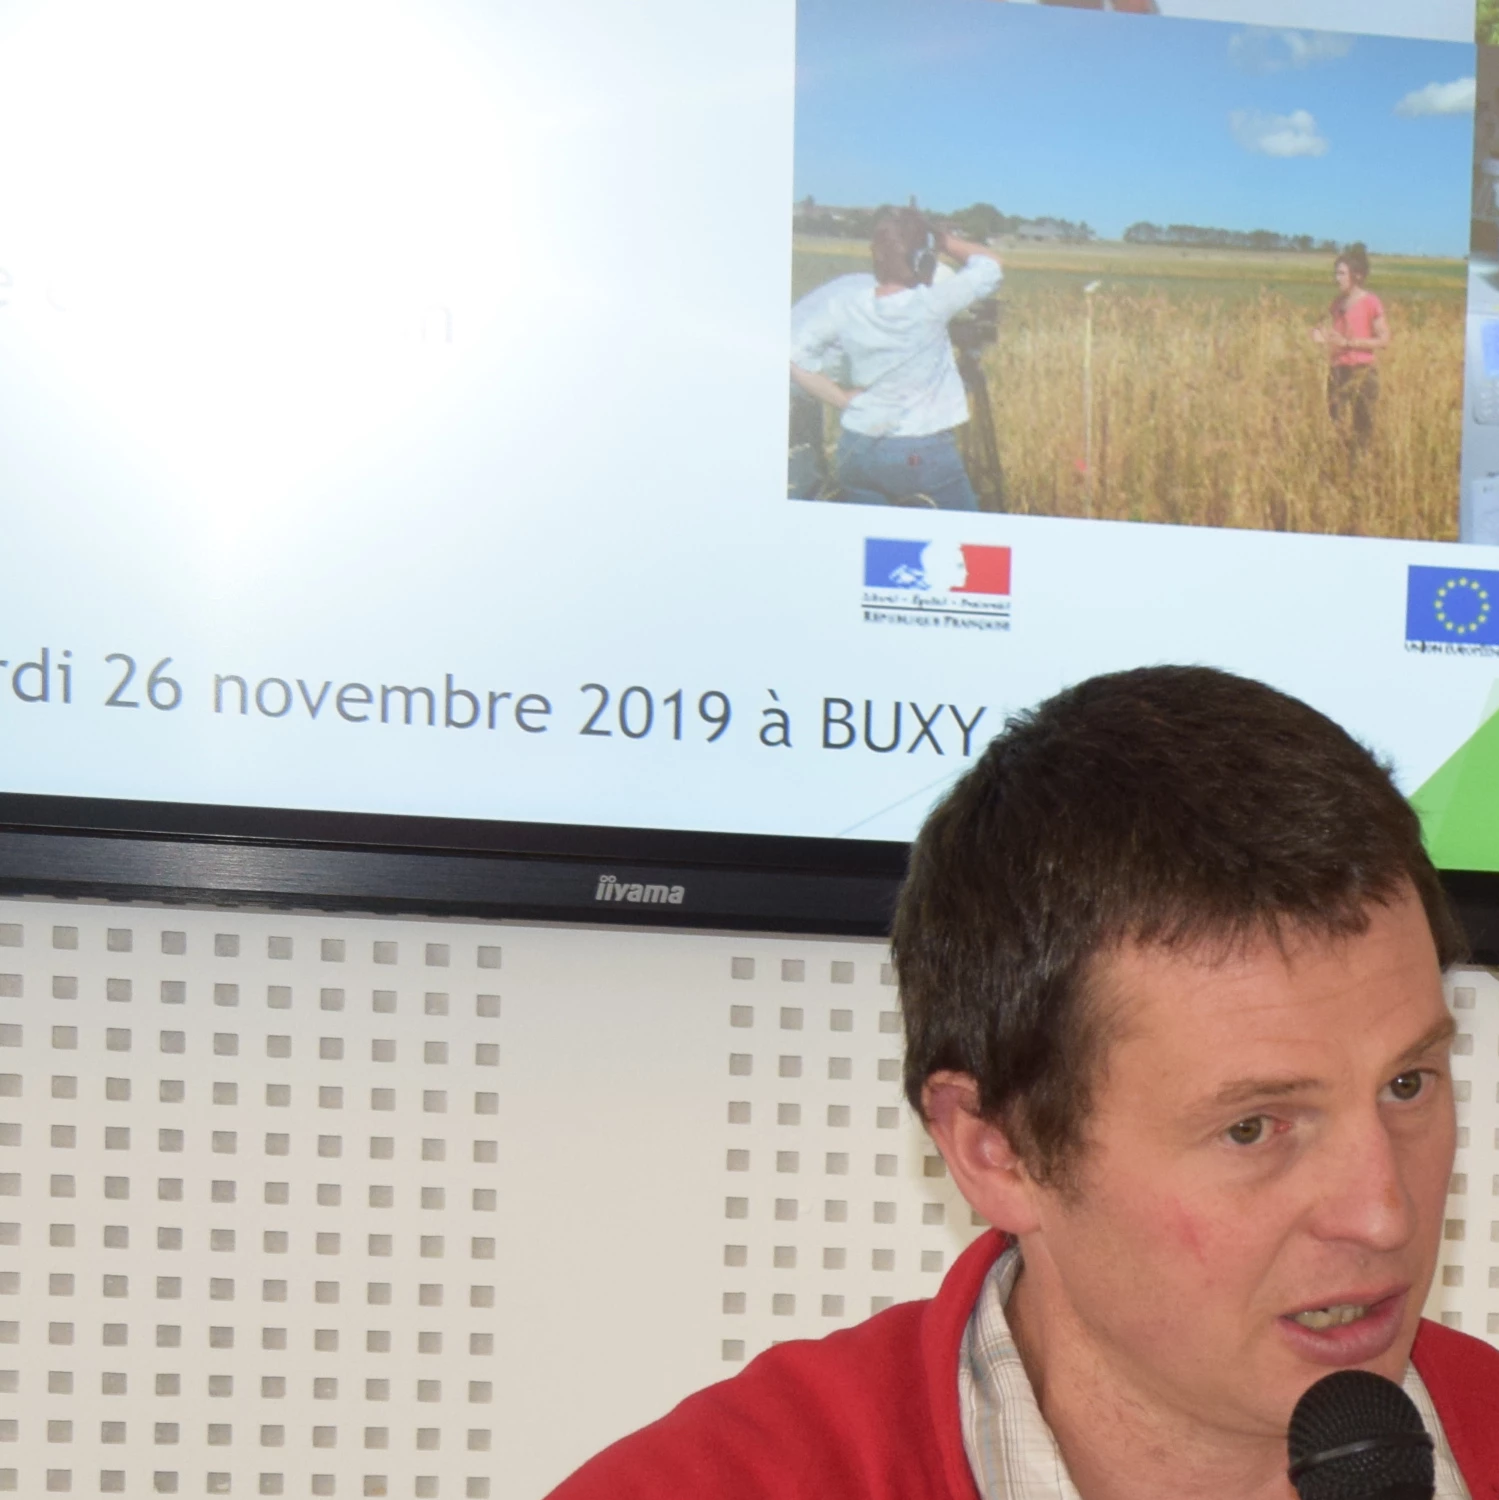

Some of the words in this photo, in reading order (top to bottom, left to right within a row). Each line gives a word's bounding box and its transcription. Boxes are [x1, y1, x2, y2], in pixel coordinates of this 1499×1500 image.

[104, 652, 183, 712] 26
[213, 672, 552, 734] novembre
[579, 683, 732, 743] 2019
[759, 689, 792, 748] à
[822, 697, 987, 757] BUXY
[596, 875, 685, 904] iiyama
